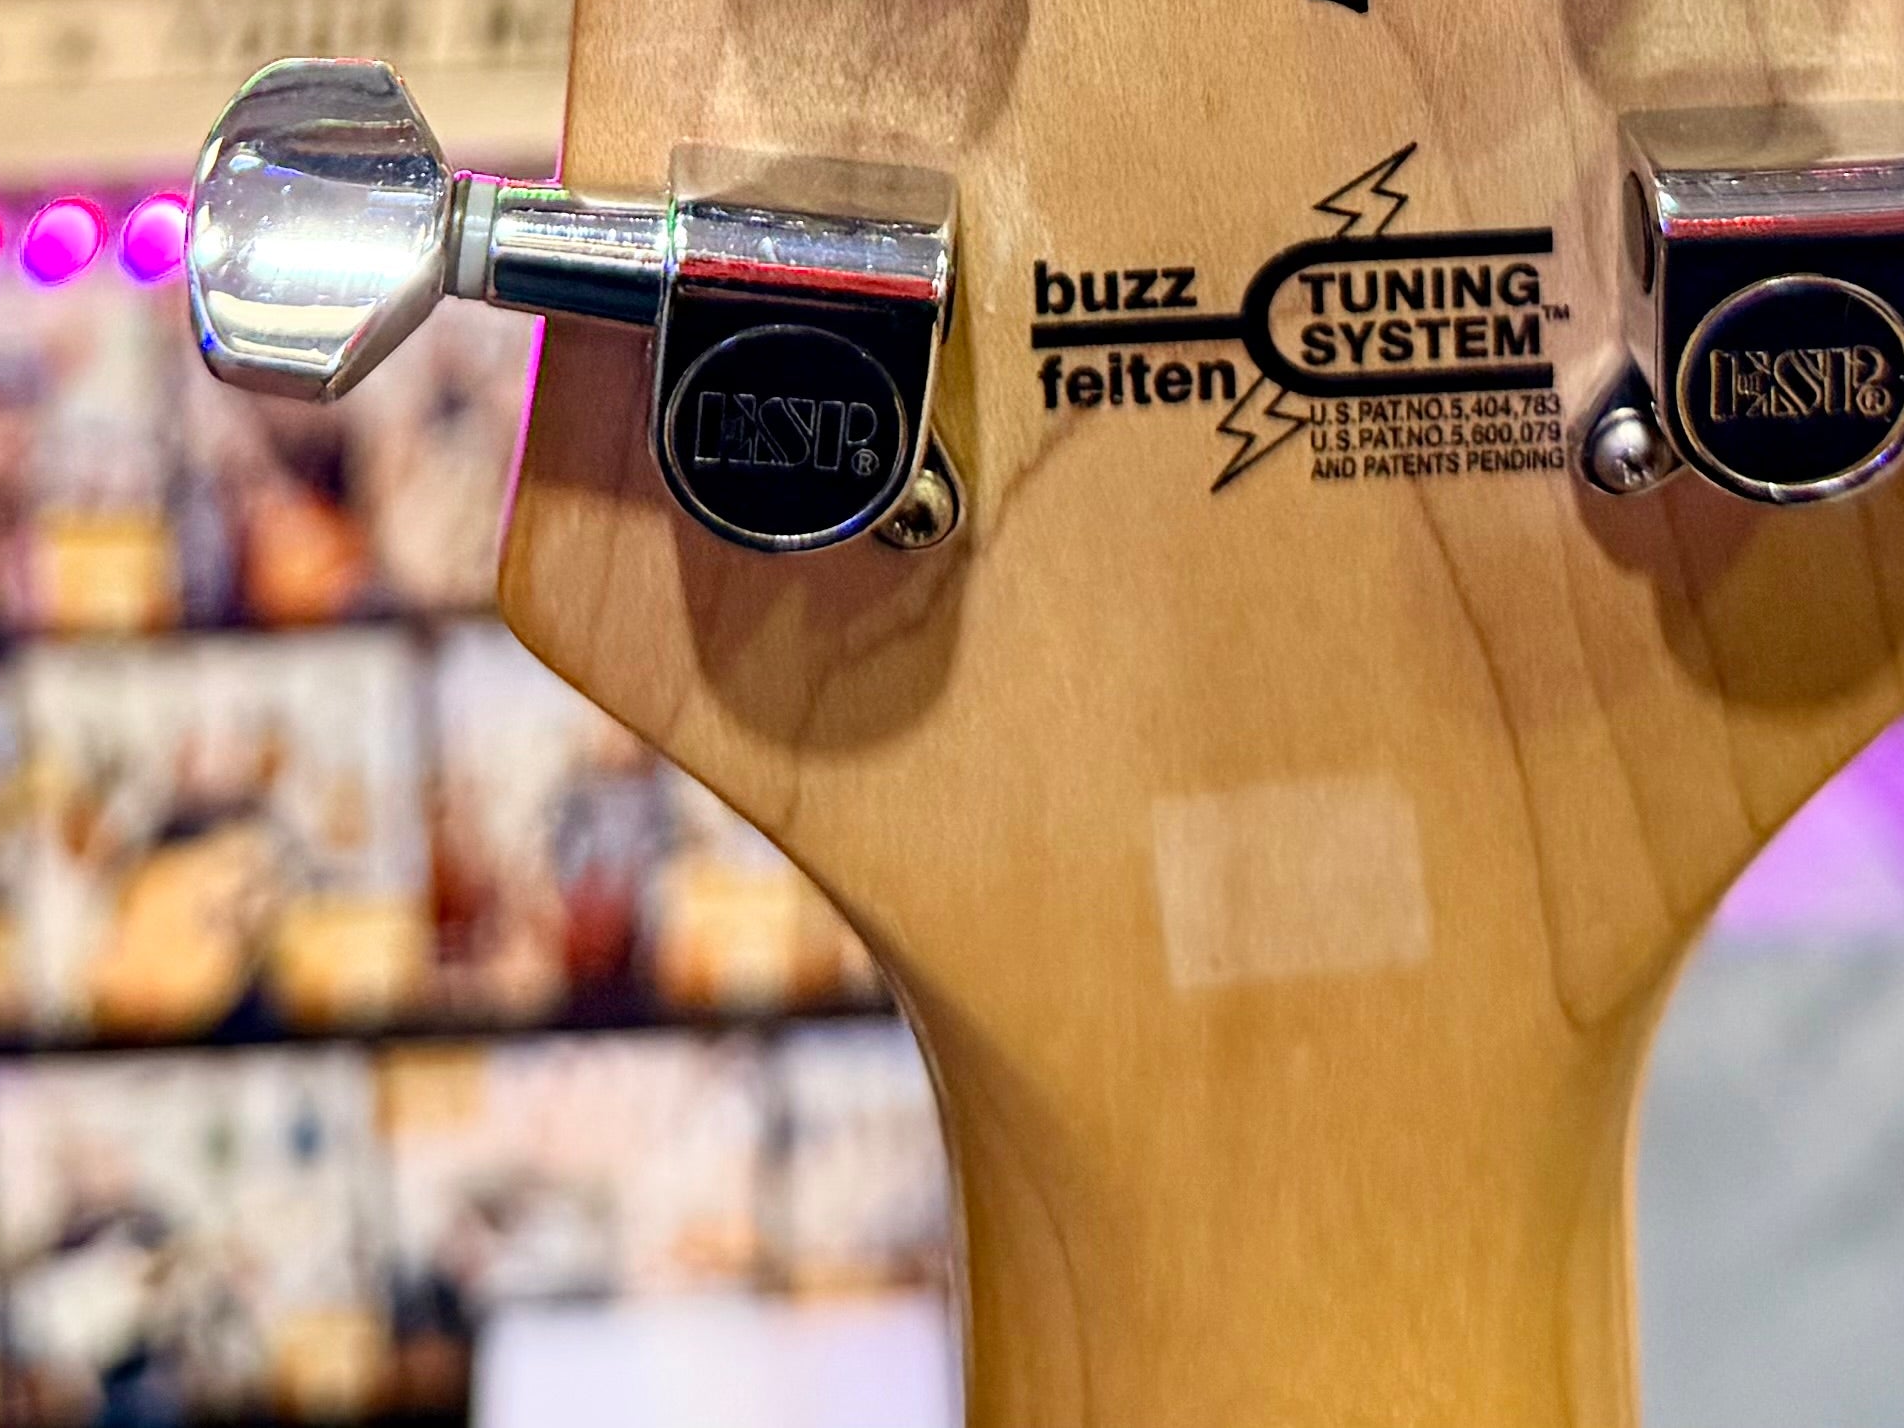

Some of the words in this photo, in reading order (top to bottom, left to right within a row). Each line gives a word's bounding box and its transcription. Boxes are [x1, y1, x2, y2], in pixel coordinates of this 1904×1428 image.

[1034, 259, 1198, 315] buzz
[1298, 262, 1541, 315] TUNING
[1037, 352, 1237, 409] feiten
[1311, 456, 1357, 480] AND
[1362, 450, 1460, 478] PATENTS
[1466, 446, 1565, 473] PENDING
